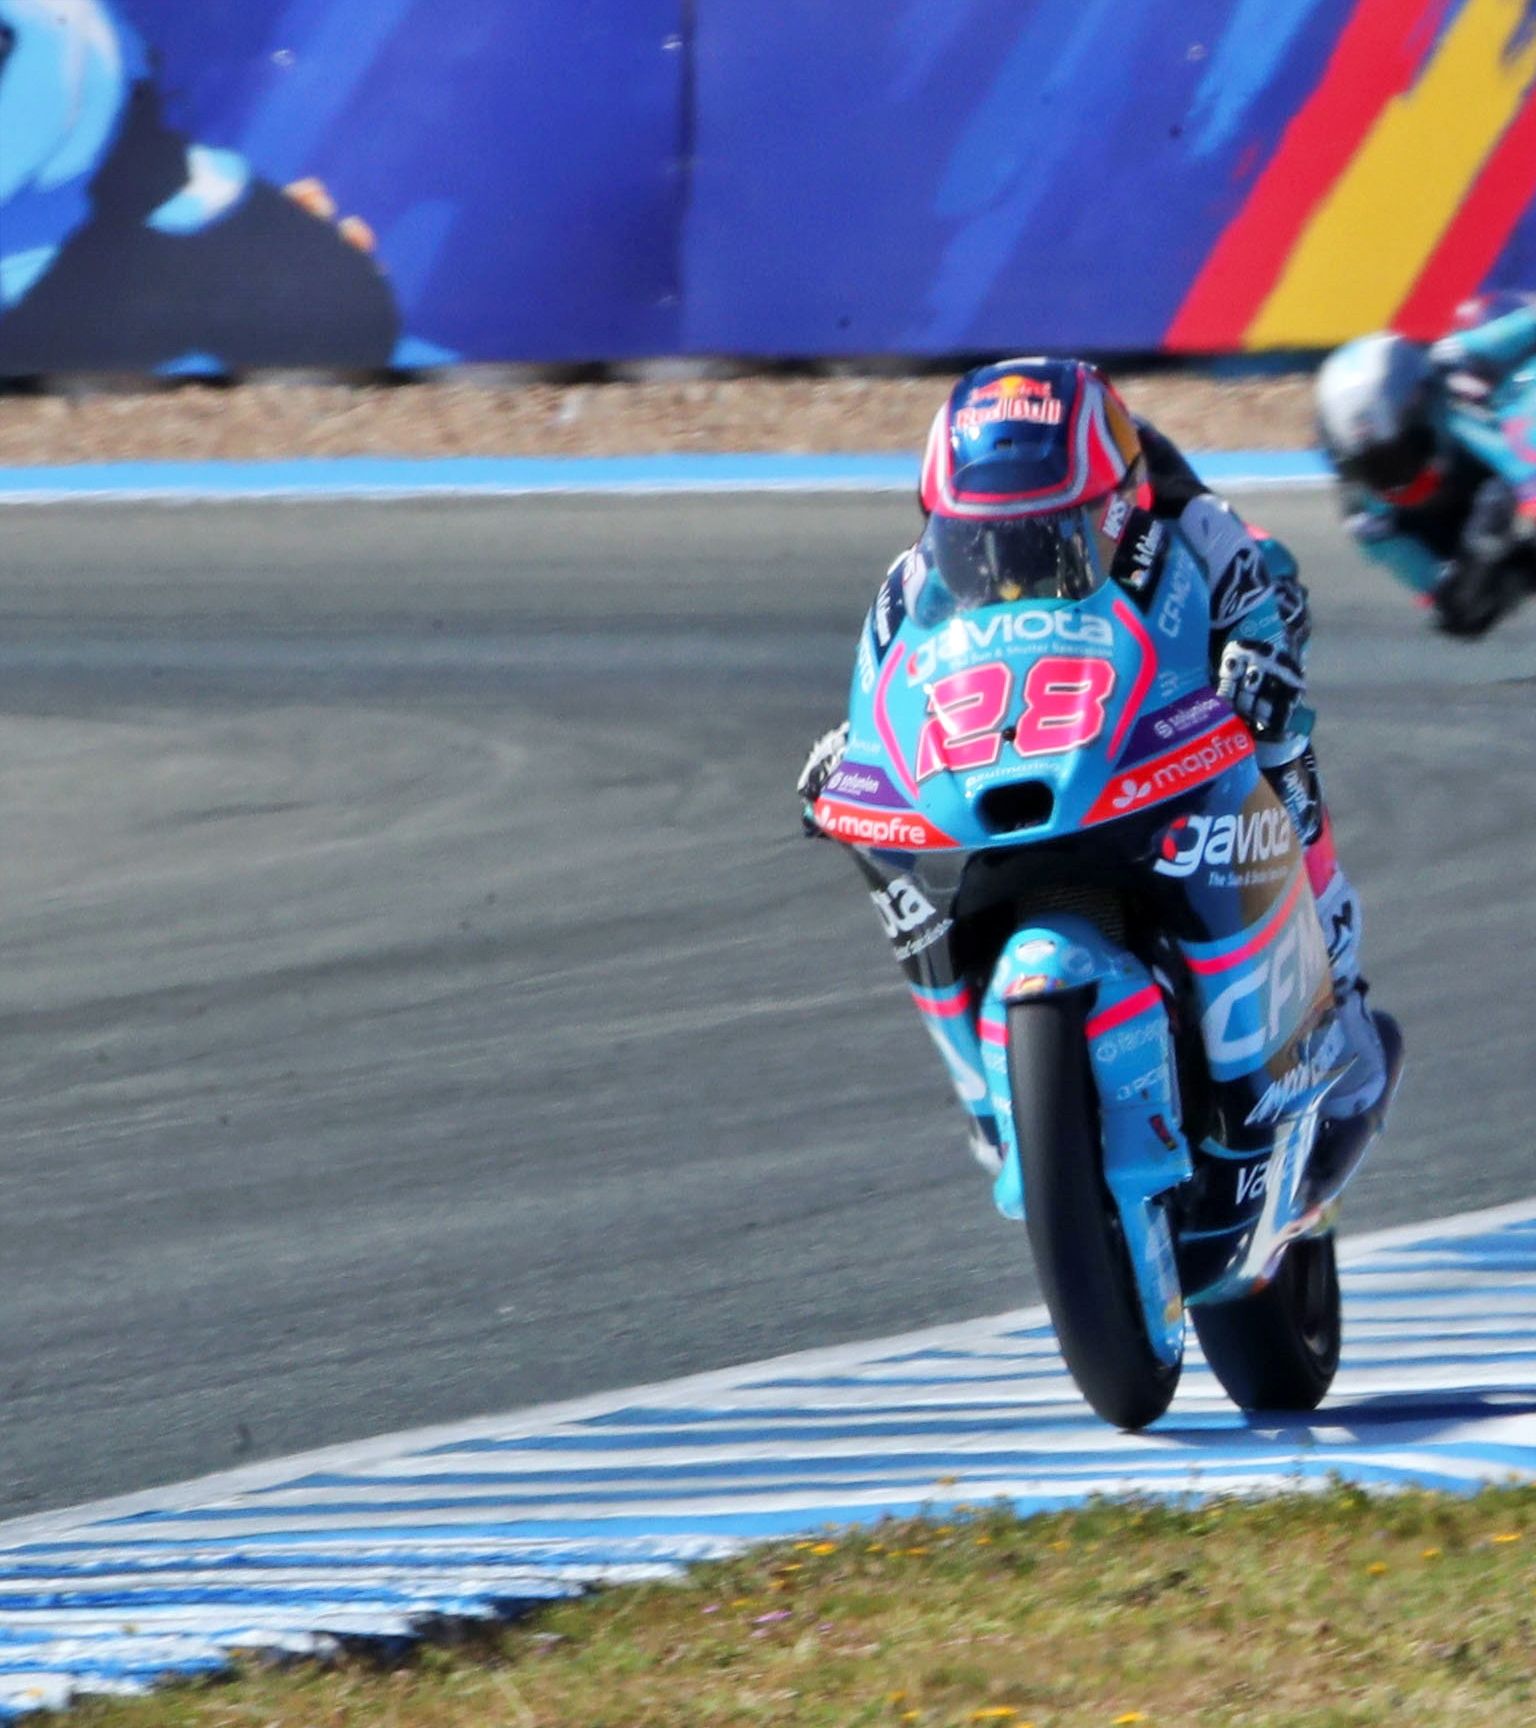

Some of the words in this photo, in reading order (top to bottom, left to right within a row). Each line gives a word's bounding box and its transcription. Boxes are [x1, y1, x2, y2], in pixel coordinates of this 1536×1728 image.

[957, 398, 1008, 428] Red
[1009, 397, 1061, 424] Bull
[907, 609, 1115, 688] gaviota
[916, 656, 1116, 782] 28
[1153, 730, 1249, 788] mapfre
[838, 814, 927, 844] mapfre
[1153, 807, 1292, 877] gaviota
